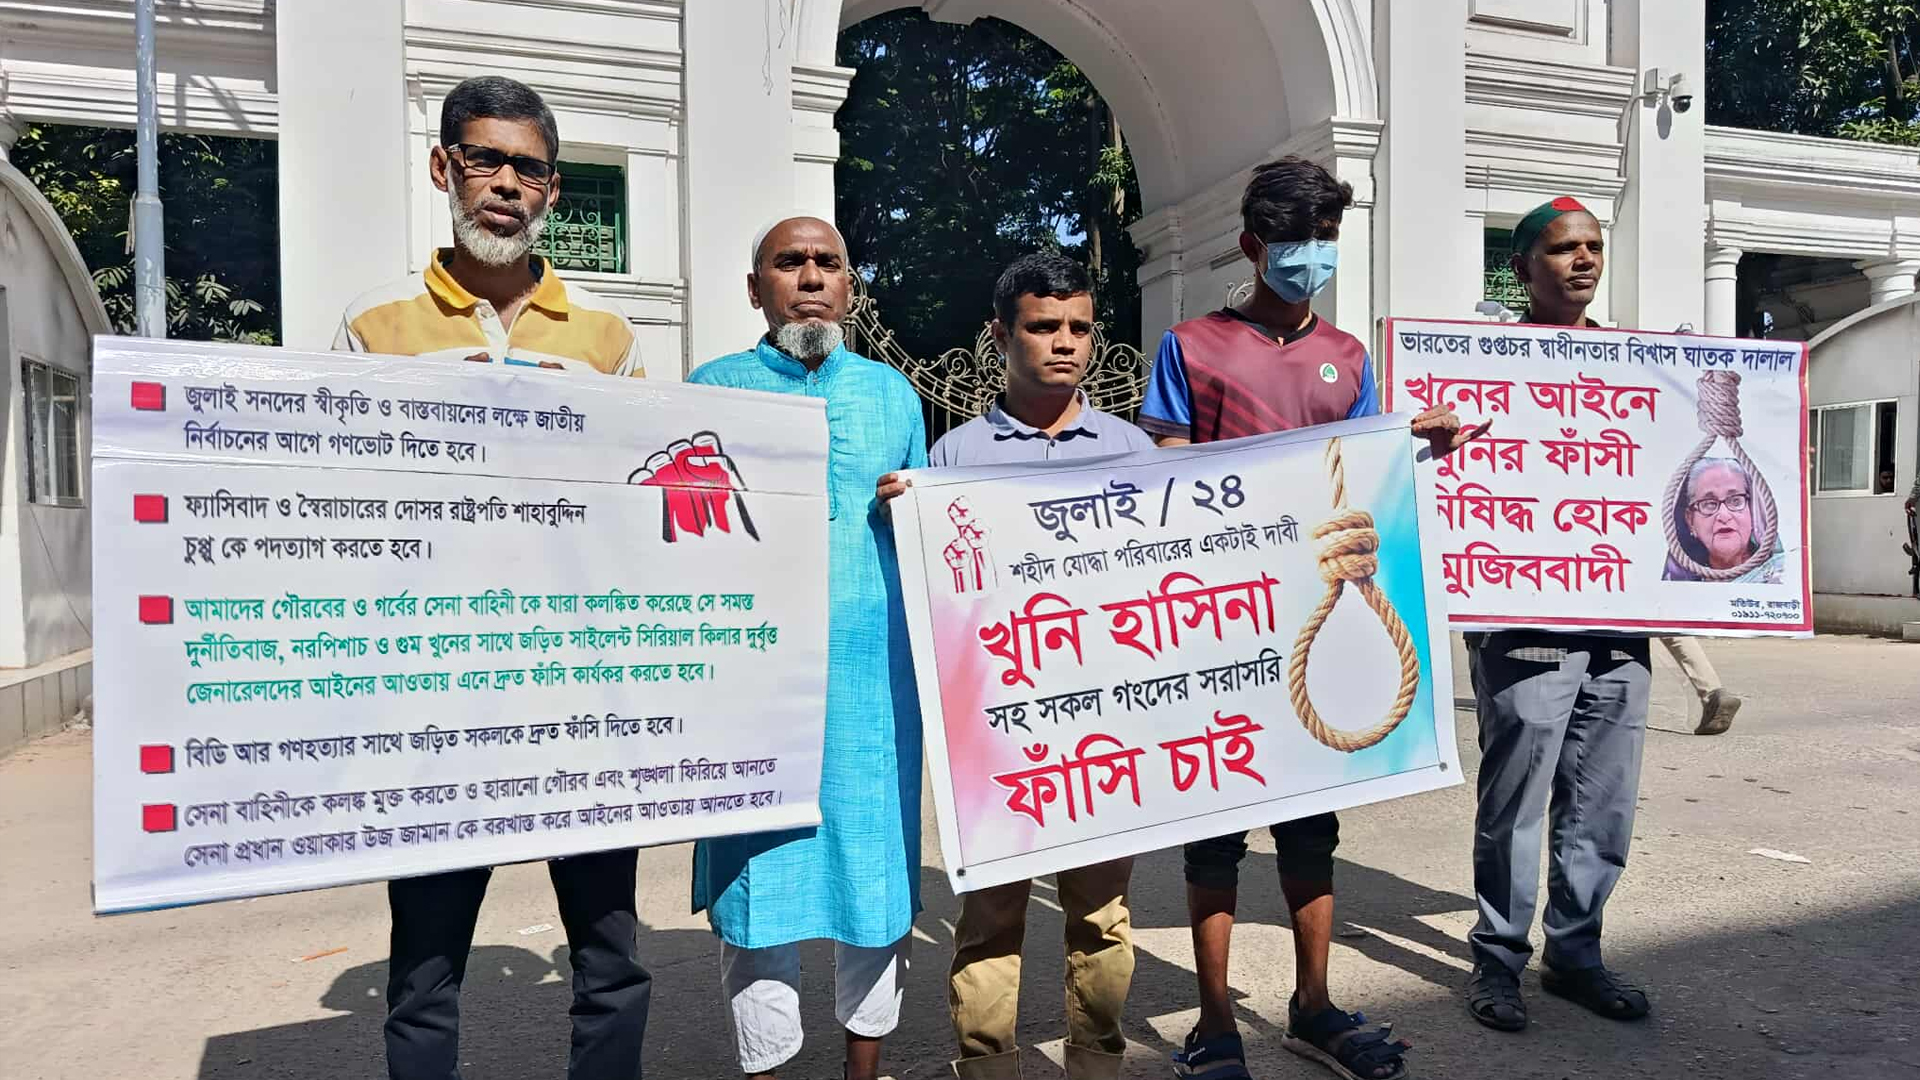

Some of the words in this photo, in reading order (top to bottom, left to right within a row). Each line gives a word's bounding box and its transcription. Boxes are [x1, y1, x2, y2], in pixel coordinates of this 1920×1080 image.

[1399, 331, 1472, 356] ভারতের
[1478, 334, 1532, 358] গুপ্তচর
[1537, 331, 1621, 362] স্বাধীনতার
[1625, 336, 1679, 367] বিশ্বাস
[1682, 345, 1736, 369] ঘাতক
[1740, 348, 1796, 372] দালাল
[184, 381, 239, 414] জুলাই
[244, 389, 308, 413] সনদের
[313, 386, 371, 425] স্বীকৃতি
[376, 398, 392, 417] ও
[397, 397, 488, 425] বাস্তবায়নের
[534, 405, 586, 434] জাতীয়
[1404, 372, 1516, 415] খনের
[1525, 371, 1661, 423] আইনে
[184, 420, 270, 452] নির্বাচনের
[275, 431, 322, 454] আগে
[328, 430, 395, 458] গণভোট
[399, 431, 441, 459] দিতে
[1539, 427, 1643, 478] ফাঁসী
[183, 488, 270, 518] ফ্যাসিবাদ
[275, 498, 291, 517] ও
[295, 491, 389, 520] স্বৈরাচারের
[394, 498, 445, 521] দোসর
[449, 495, 509, 524] রাষ্ট্রপতি
[512, 497, 587, 529] শাহাবুদ্দিন
[1027, 479, 1146, 544] জুলাই
[1159, 477, 1176, 528] /
[1192, 474, 1247, 516] ২৪
[1553, 495, 1653, 537] হোক
[221, 537, 248, 559] কে
[254, 535, 327, 560] পদত্যাগ
[330, 537, 385, 559] করতে
[1009, 552, 1057, 585] শহীদ
[1062, 548, 1109, 578] যোদ্ধা
[1114, 538, 1193, 570] পরিবারের
[1199, 524, 1260, 556] একটাই
[1262, 514, 1299, 546] দাবী
[1441, 541, 1632, 599] মুজিববাদী
[184, 597, 265, 623] আমাদের
[272, 591, 347, 620] গৌরবের
[352, 598, 368, 617] ও
[374, 589, 419, 618] গর্বের
[424, 594, 463, 617] সেনা
[467, 588, 516, 617] বাহিনী
[520, 595, 542, 615] কে
[546, 593, 580, 614] যারা
[583, 588, 641, 614] কলঙ্কিত
[644, 594, 694, 614] করেছে
[697, 594, 716, 612] সে
[720, 593, 755, 612] সমস্ত
[977, 592, 1089, 690] খুনি
[1098, 570, 1281, 662] হাসিনা
[184, 632, 285, 669] দুর্নীতিবাজ,
[290, 631, 370, 660] নরপিশাচ
[375, 637, 390, 655] ও
[395, 634, 423, 654] গুম
[427, 632, 473, 660] খুনের
[476, 631, 514, 653] সাথে
[518, 625, 565, 654] জড়িত
[569, 624, 632, 651] সাইলেন্ট
[636, 623, 695, 648] সিরিয়াল
[699, 622, 742, 647] কিলার
[186, 678, 304, 705] জেনারেলদের
[308, 671, 378, 699] আইনের
[381, 671, 451, 694] আওতায়
[457, 670, 491, 692] এনে
[494, 668, 526, 692] দ্রুত
[530, 661, 567, 689] ফাঁসি
[571, 660, 625, 685] কার্যকর
[629, 663, 675, 683] করতে
[984, 702, 1033, 734] সহ
[1035, 688, 1104, 724] সকল
[1112, 672, 1191, 712] গংদের
[1196, 647, 1282, 695] সরাসরি
[184, 737, 229, 768] বিডি
[233, 740, 272, 766] আর
[278, 735, 358, 764] গণহত্যার
[362, 731, 404, 756] সাথে
[408, 724, 460, 755] জড়িত
[464, 725, 526, 749] সকলকে
[529, 722, 562, 746] দ্রুত
[565, 714, 600, 741] ফাঁসি
[605, 712, 642, 739] দিতে
[184, 801, 230, 828] সেনা
[234, 790, 318, 824] বাহিনীকে
[319, 791, 367, 815] কলঙ্ক
[371, 787, 404, 815] মুক্ত
[407, 783, 460, 807] করতে
[465, 782, 479, 801] ও
[482, 774, 540, 801] হারানো
[545, 767, 590, 795] গৌরব
[594, 769, 626, 791] এবং
[679, 757, 729, 783] ফিরিয়ে
[732, 757, 778, 778] আনতে
[992, 733, 1147, 828] ফাঁসি
[1157, 710, 1267, 793] চাই
[184, 840, 229, 868] সেনা
[234, 837, 286, 864] প্রধান
[292, 830, 358, 857] ওয়াকার
[360, 823, 395, 848] উজ
[400, 821, 452, 846] জামান
[456, 819, 479, 840] কে
[482, 812, 536, 836] বরখাস্ত
[539, 810, 572, 829] করে
[577, 801, 634, 828] আইনের
[638, 797, 695, 820] আওতায়
[699, 793, 747, 814] আনতে
